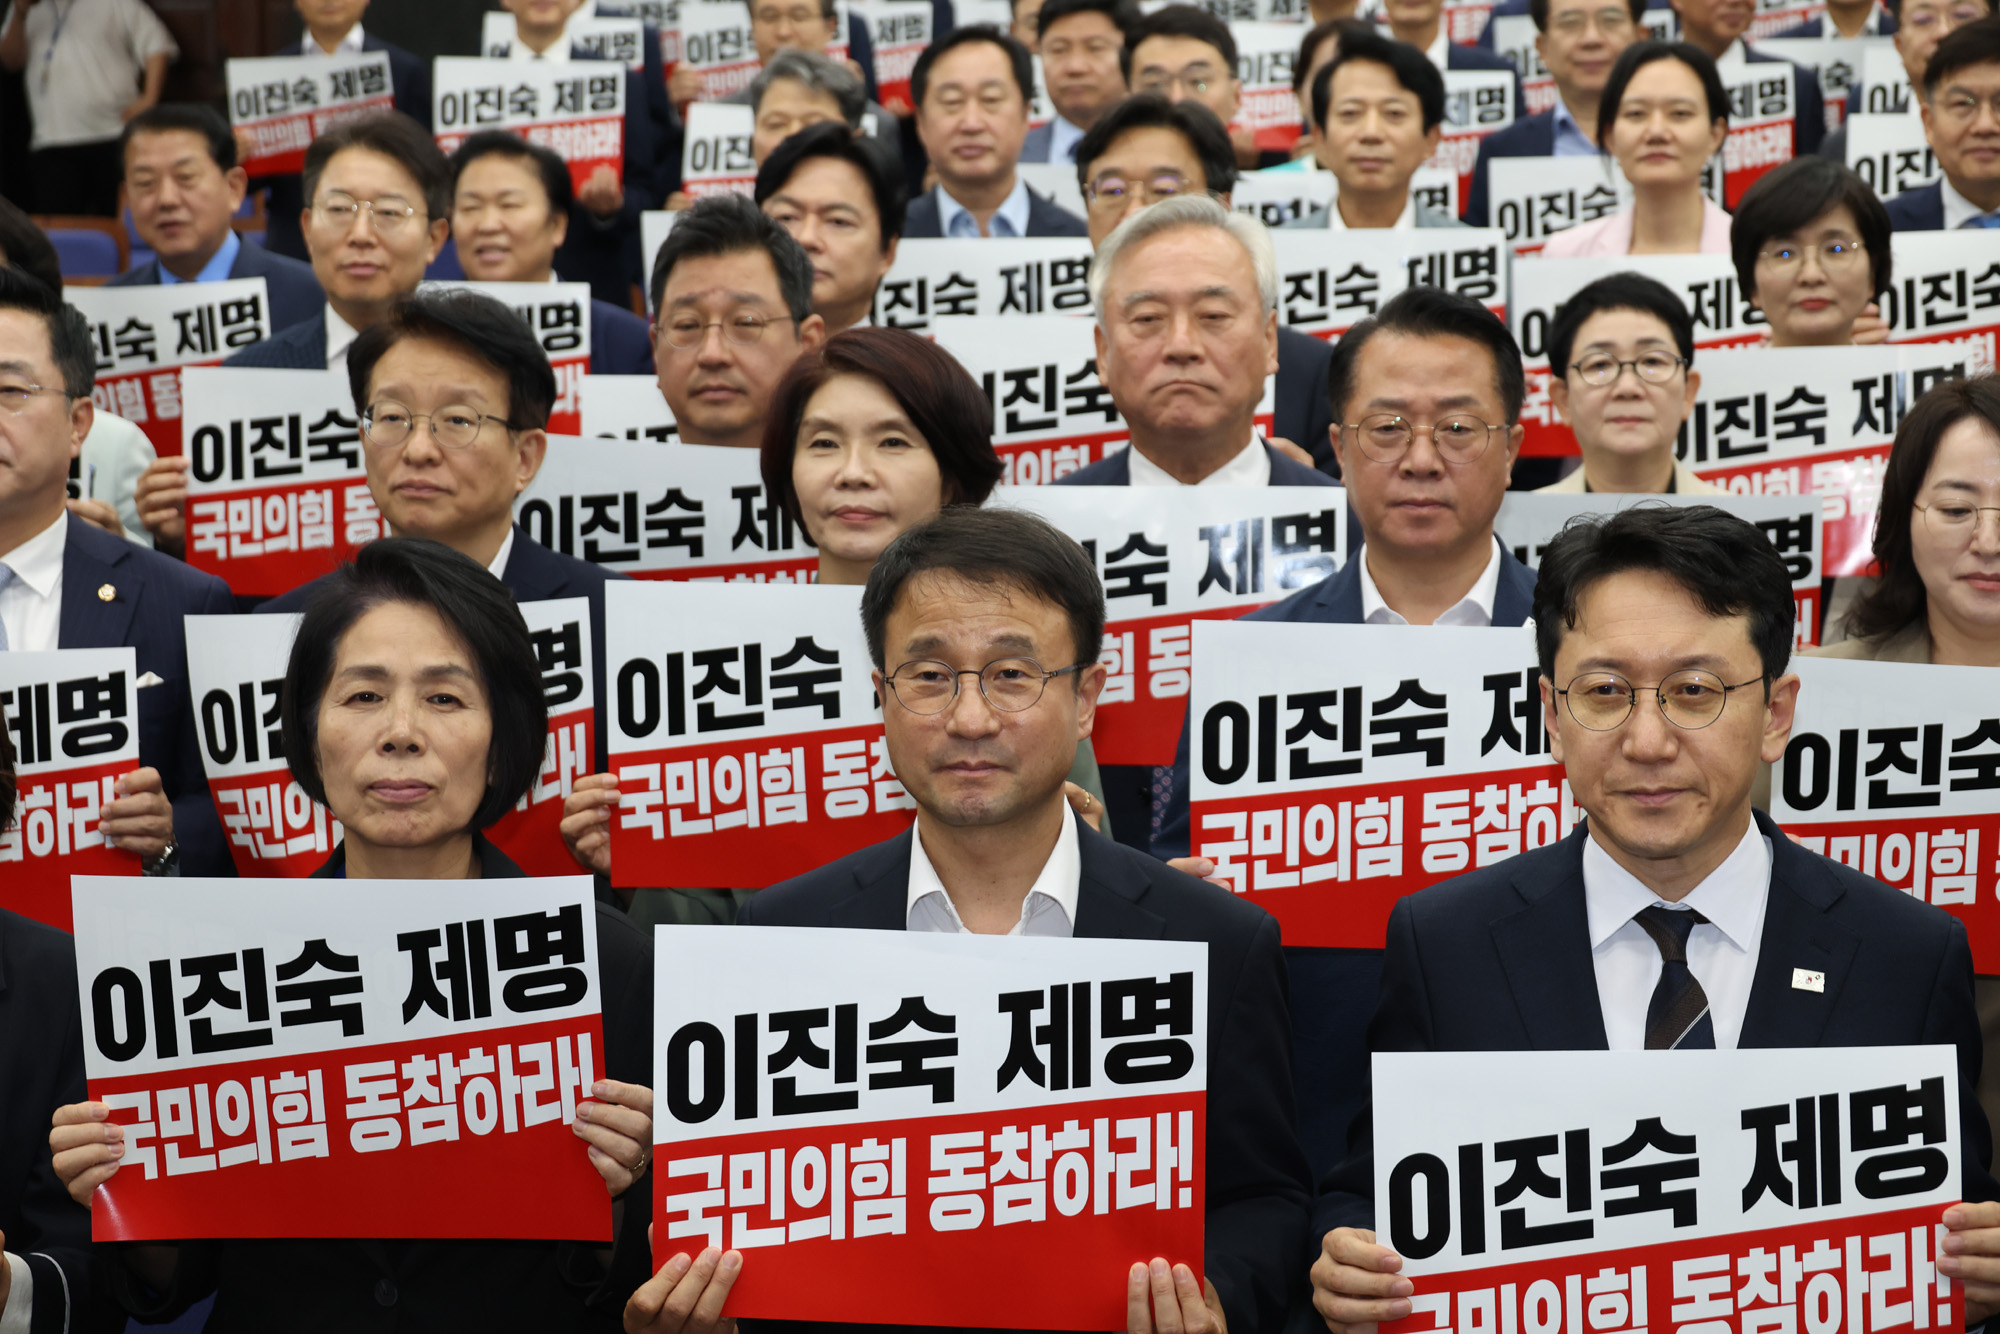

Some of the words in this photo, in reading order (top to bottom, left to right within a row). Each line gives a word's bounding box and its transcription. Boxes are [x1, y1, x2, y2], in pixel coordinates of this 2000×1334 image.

[686, 26, 755, 63] 이진
[1237, 52, 1300, 84] 이진
[236, 75, 319, 118] 이진숙
[329, 64, 386, 99] 제명
[441, 82, 539, 126] 이진숙
[553, 75, 619, 113] 제명
[691, 135, 754, 172] 이진
[1855, 148, 1934, 195] 이진
[523, 299, 583, 352] 명
[872, 271, 979, 329] 진숙
[999, 254, 1095, 316] 제명
[1283, 262, 1379, 325] 진숙
[88, 317, 157, 371] 진숙
[173, 294, 263, 355] 제명
[192, 409, 363, 483] 이진숙
[192, 488, 335, 561] 국민의힘
[520, 488, 705, 564] 이진숙
[1198, 508, 1338, 598] 제명
[529, 621, 584, 708] 명
[617, 635, 842, 739] 이진숙
[1202, 678, 1449, 785] 이진숙
[1481, 667, 1552, 758] 제
[1782, 719, 2000, 812] 이진숙
[217, 779, 345, 860] 국민의
[618, 746, 808, 841] 국민의힘
[1201, 795, 1404, 893] 국민의힘
[1421, 778, 1588, 874] 동참하
[91, 938, 364, 1062] 이진숙
[396, 903, 589, 1026] 제명
[666, 996, 959, 1124] 이진숙
[997, 971, 1195, 1094] 제명
[101, 1068, 330, 1181] 국민의힘
[344, 1032, 595, 1154] 동참하라!
[666, 1137, 907, 1250] 국민의힘
[928, 1110, 1194, 1232] 동참하라!
[1388, 1116, 1700, 1261] 이진숙
[1740, 1075, 1950, 1215] 제명
[1671, 1224, 1953, 1334] 동참하라!
